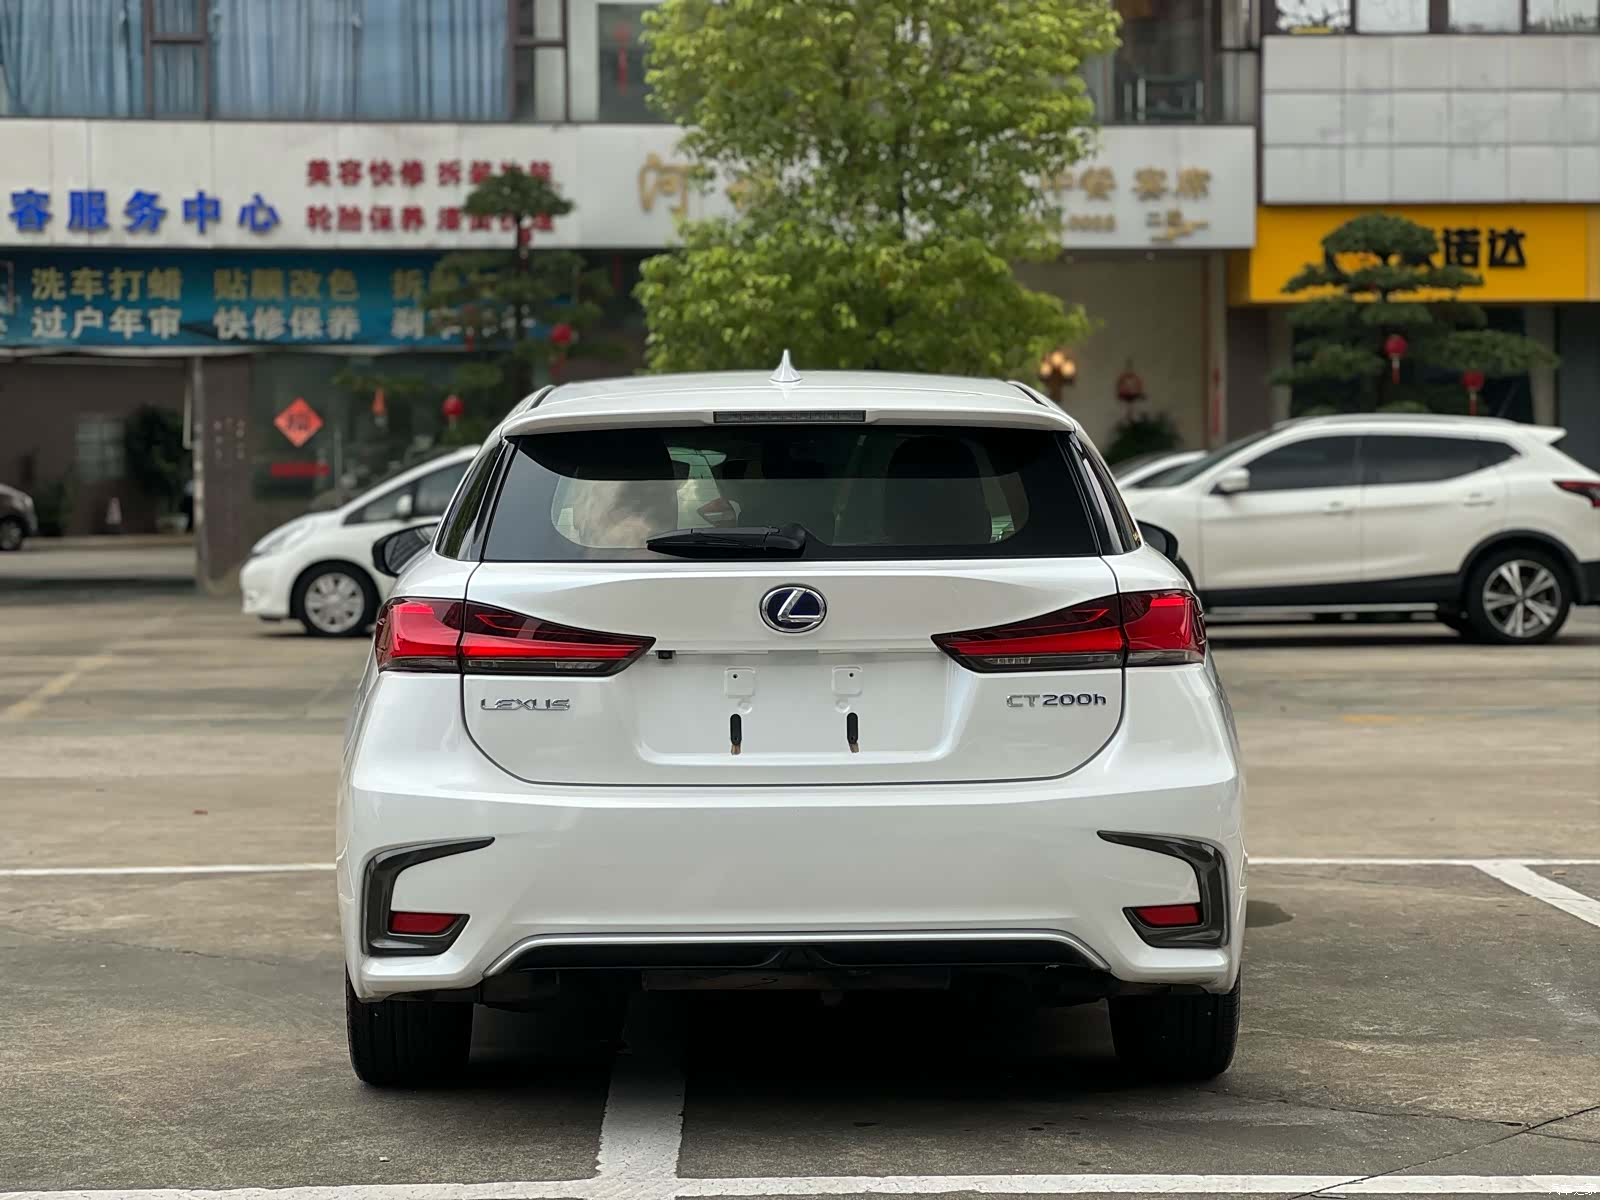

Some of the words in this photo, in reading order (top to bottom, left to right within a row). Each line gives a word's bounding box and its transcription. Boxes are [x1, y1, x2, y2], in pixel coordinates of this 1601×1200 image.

[9, 188, 281, 236] 容服务中心
[306, 205, 425, 233] 轮胎保养
[31, 267, 182, 300] 洗车打蜡
[213, 267, 359, 300] 贴膜改色
[31, 305, 182, 340] 过户年审
[212, 305, 361, 340] 快修保养
[480, 698, 571, 711] LEXUS
